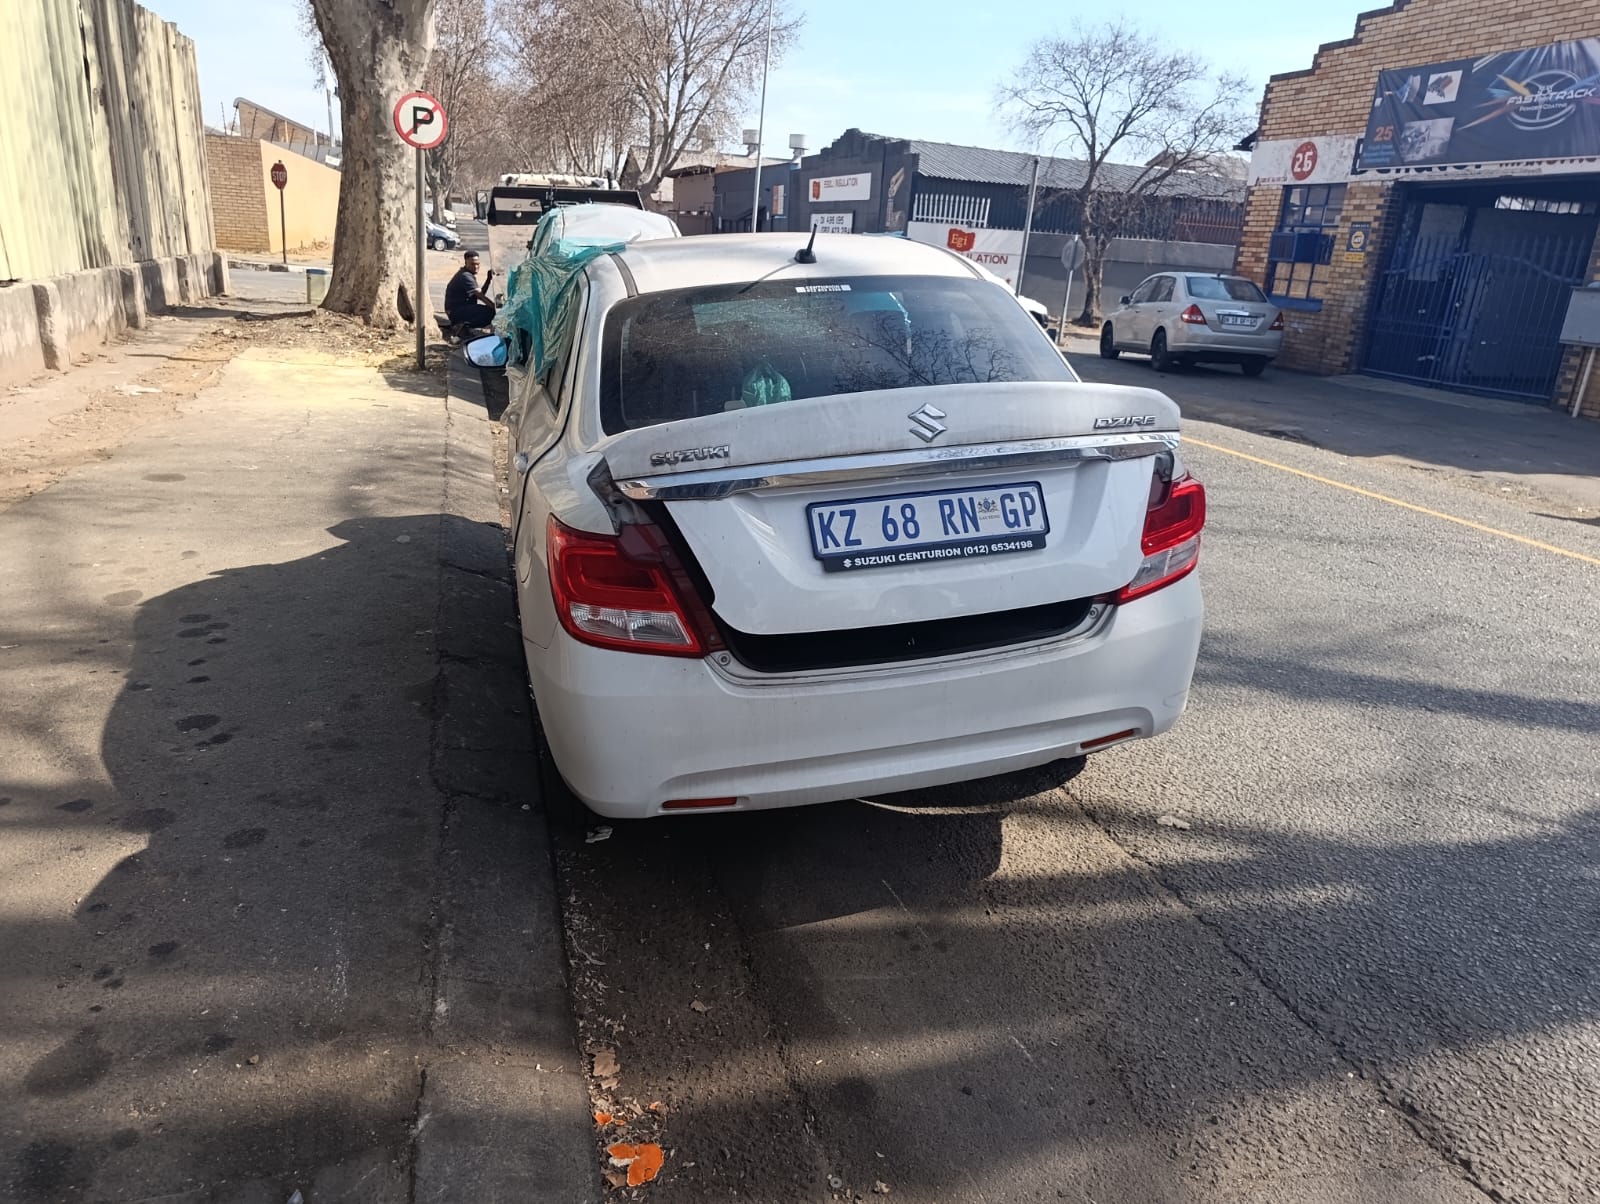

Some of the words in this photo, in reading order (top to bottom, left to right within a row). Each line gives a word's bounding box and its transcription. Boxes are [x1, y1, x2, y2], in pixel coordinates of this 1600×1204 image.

[413, 106, 434, 134] P
[1374, 127, 1394, 142] 25
[1293, 150, 1314, 173] 26
[272, 170, 287, 182] STOP
[951, 233, 968, 248] Egi
[1093, 414, 1157, 430] DZIRE
[650, 445, 729, 467] SUZUKI
[818, 508, 862, 549] KZ
[881, 503, 920, 542] 68
[938, 496, 981, 536] RN
[1000, 491, 1037, 529] GP
[854, 554, 896, 567] SUZUKI
[898, 547, 961, 563] CENTURION
[963, 544, 989, 557] (012)
[991, 540, 1033, 553] 6534198
